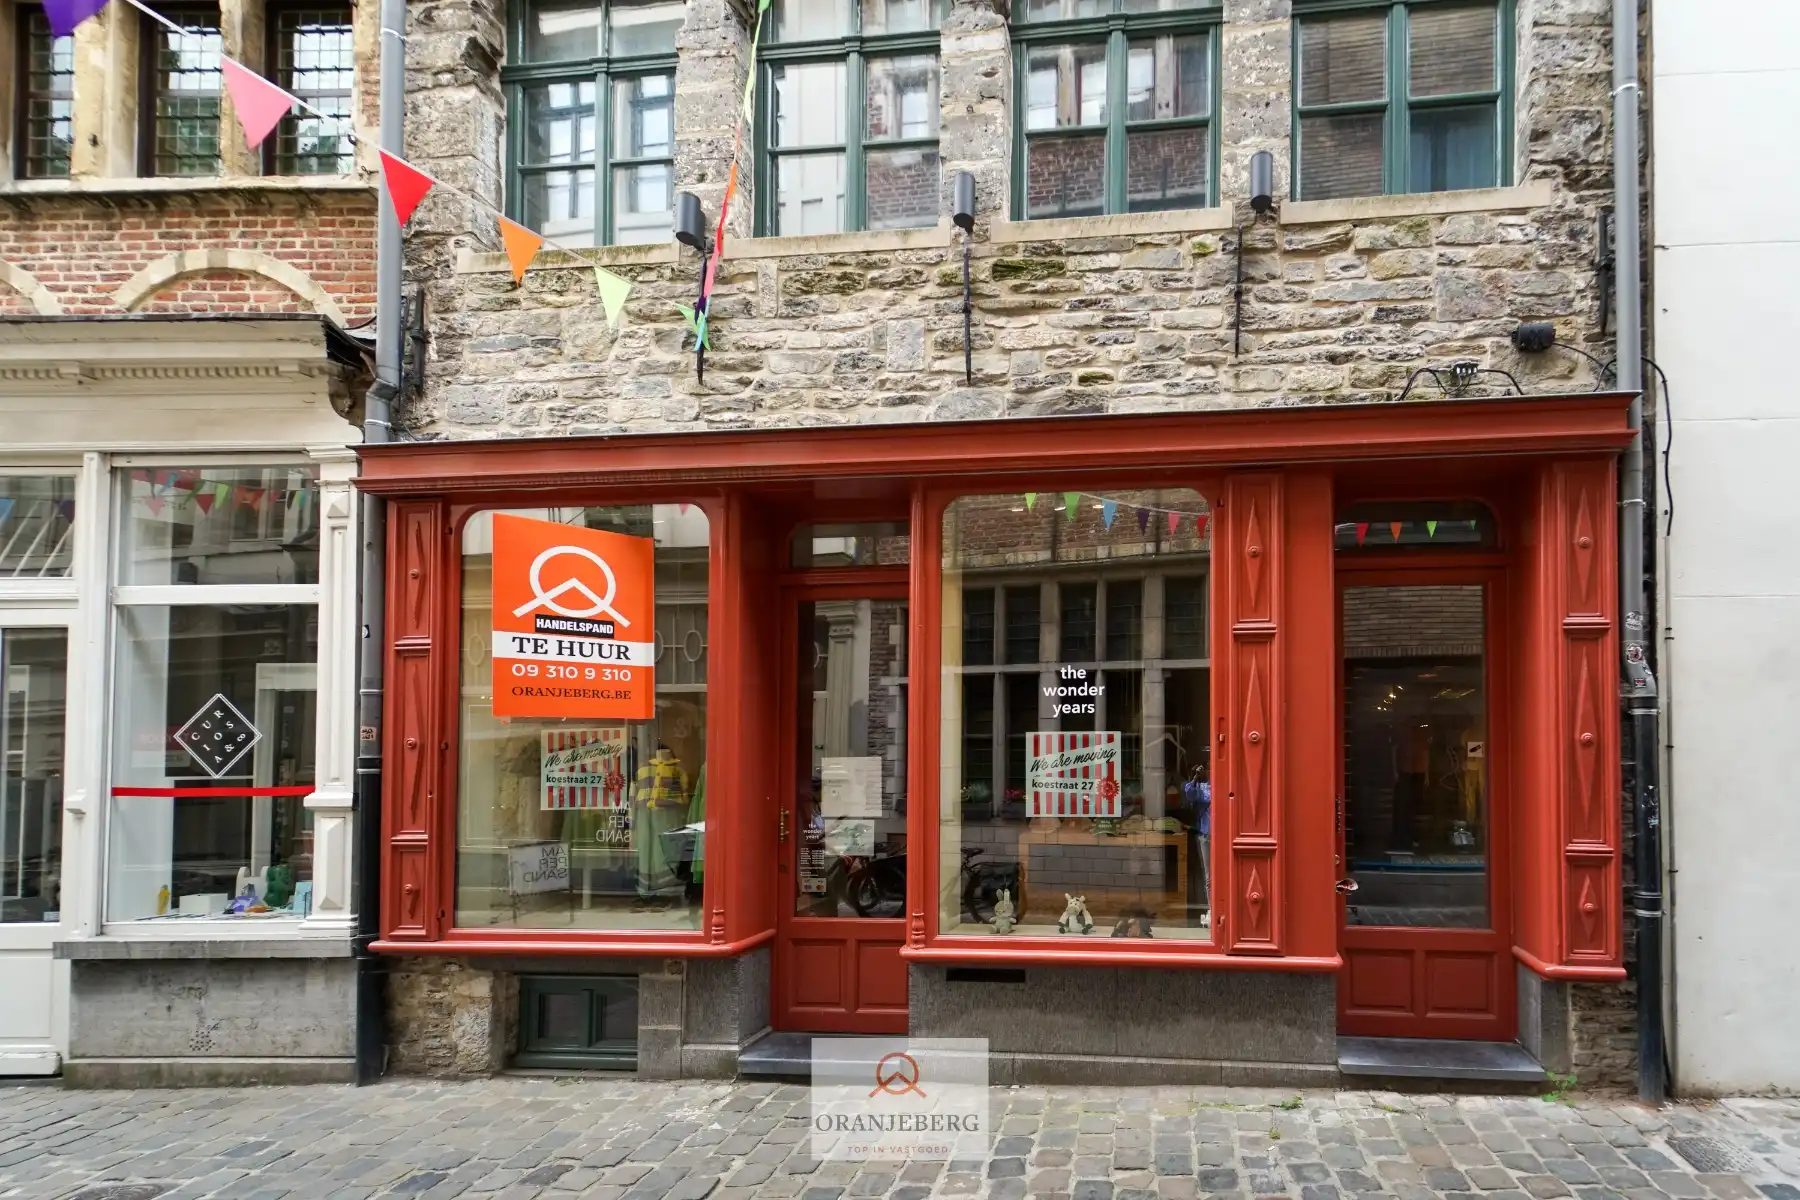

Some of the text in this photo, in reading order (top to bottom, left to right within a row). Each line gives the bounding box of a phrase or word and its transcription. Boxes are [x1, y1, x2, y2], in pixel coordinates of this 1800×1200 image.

[536, 618, 614, 634] HANDELSPAND
[512, 636, 631, 660] TE HUUR
[511, 663, 632, 682] 09 310 9 310
[1060, 664, 1087, 679] the
[511, 686, 632, 700] ORANJEBERG.BE
[1043, 682, 1105, 697] wonder
[1052, 702, 1096, 718] years
[544, 743, 622, 768] We are moving
[1030, 748, 1117, 773] We are moving
[546, 774, 588, 784] koestraat
[590, 775, 602, 784] 27
[1031, 778, 1078, 790] koestraat
[1081, 781, 1094, 790] 27
